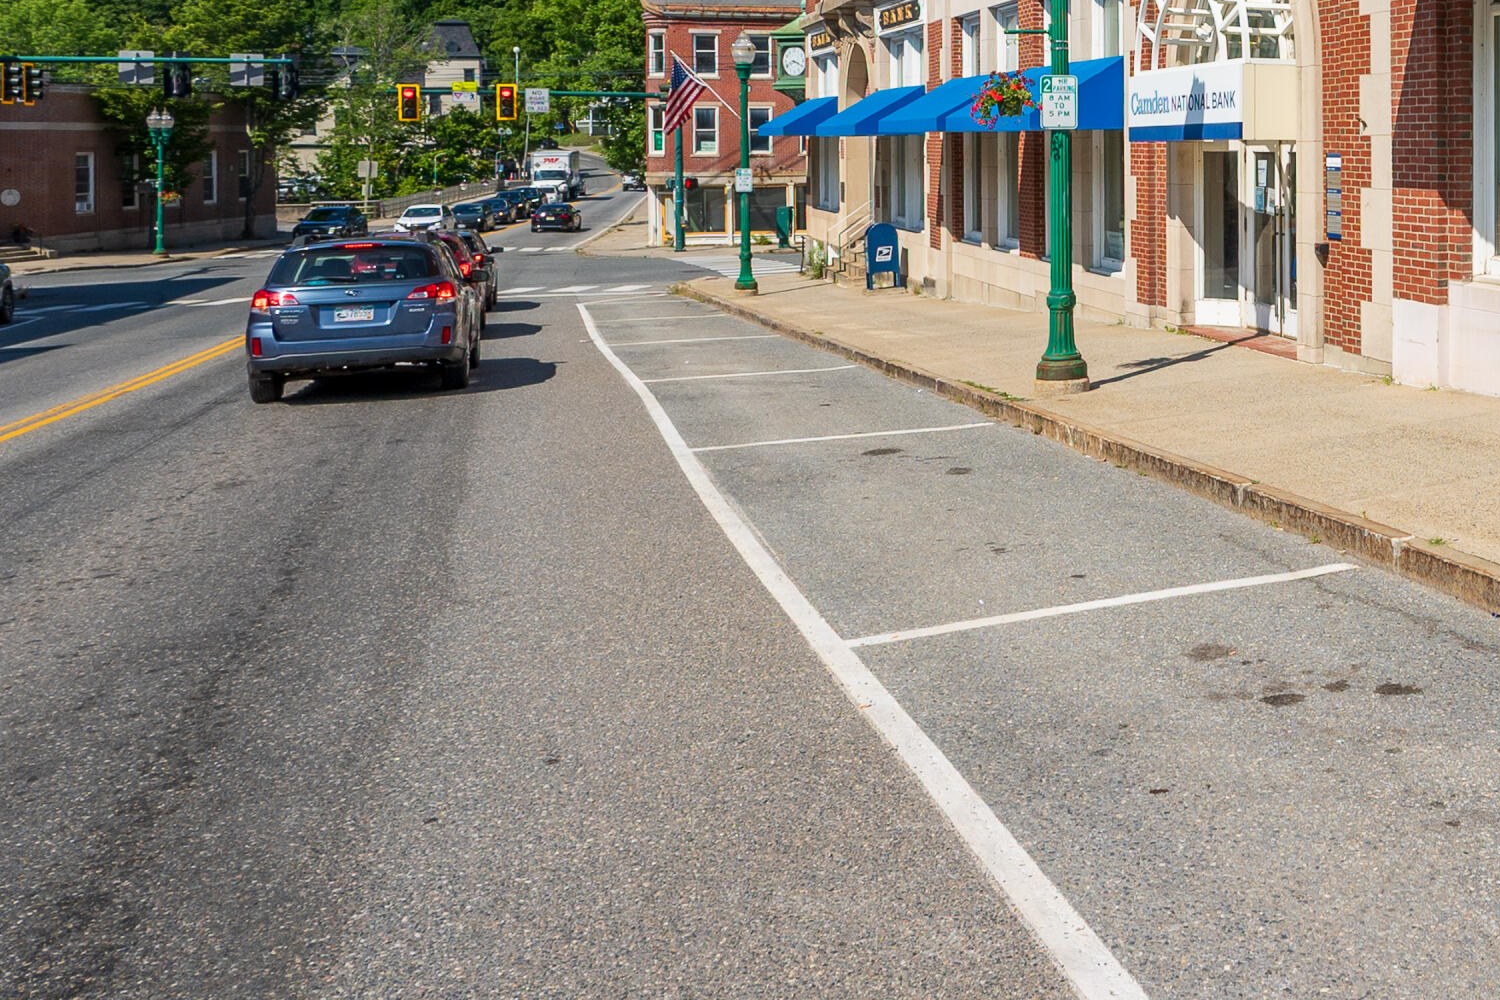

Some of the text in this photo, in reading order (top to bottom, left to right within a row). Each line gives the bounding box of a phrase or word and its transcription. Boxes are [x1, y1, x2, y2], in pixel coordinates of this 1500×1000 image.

[882, 3, 912, 26] BANK
[1043, 78, 1052, 92] 2
[1131, 90, 1236, 116] Camden NATIONAL BANK
